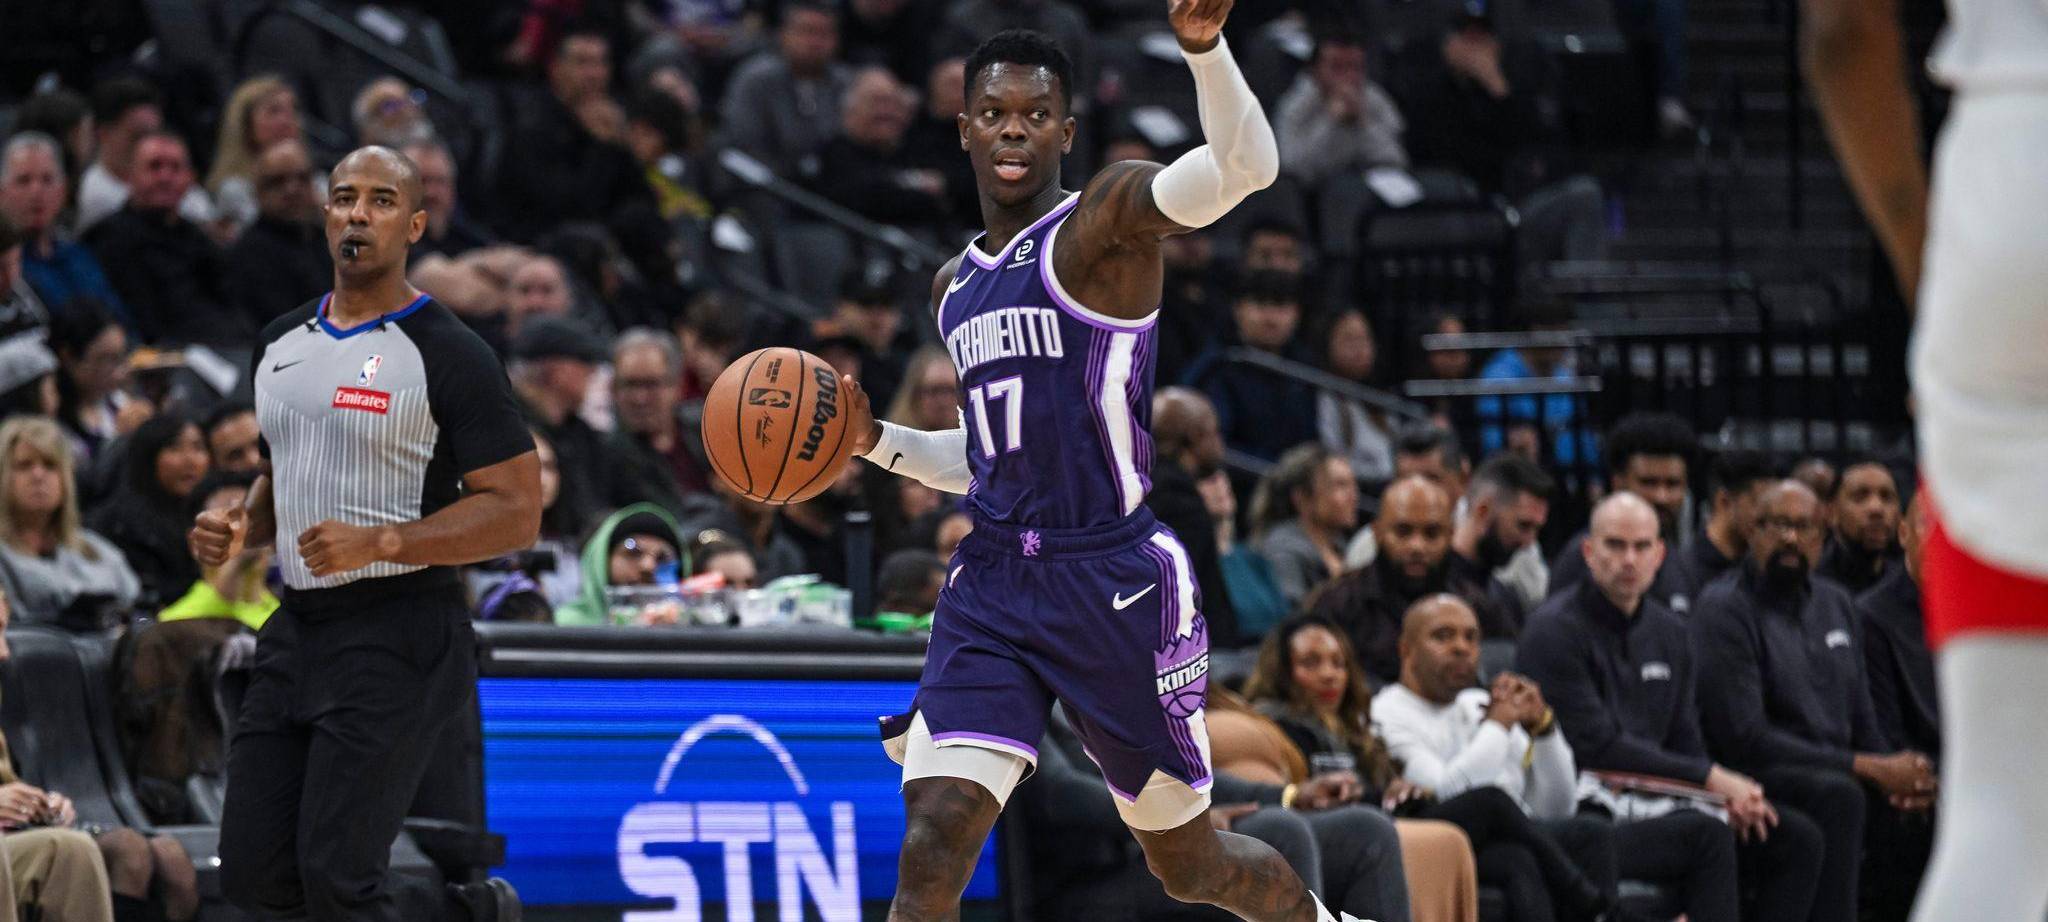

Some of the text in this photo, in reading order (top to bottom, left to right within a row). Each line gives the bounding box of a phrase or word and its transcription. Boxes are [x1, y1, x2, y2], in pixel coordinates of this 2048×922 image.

[946, 307, 1064, 382] CRAMENTO
[334, 390, 387, 409] Emirates
[796, 367, 837, 461] Wilson
[969, 375, 1023, 460] 17
[1156, 654, 1209, 695] KINGS
[616, 801, 862, 922] STN
